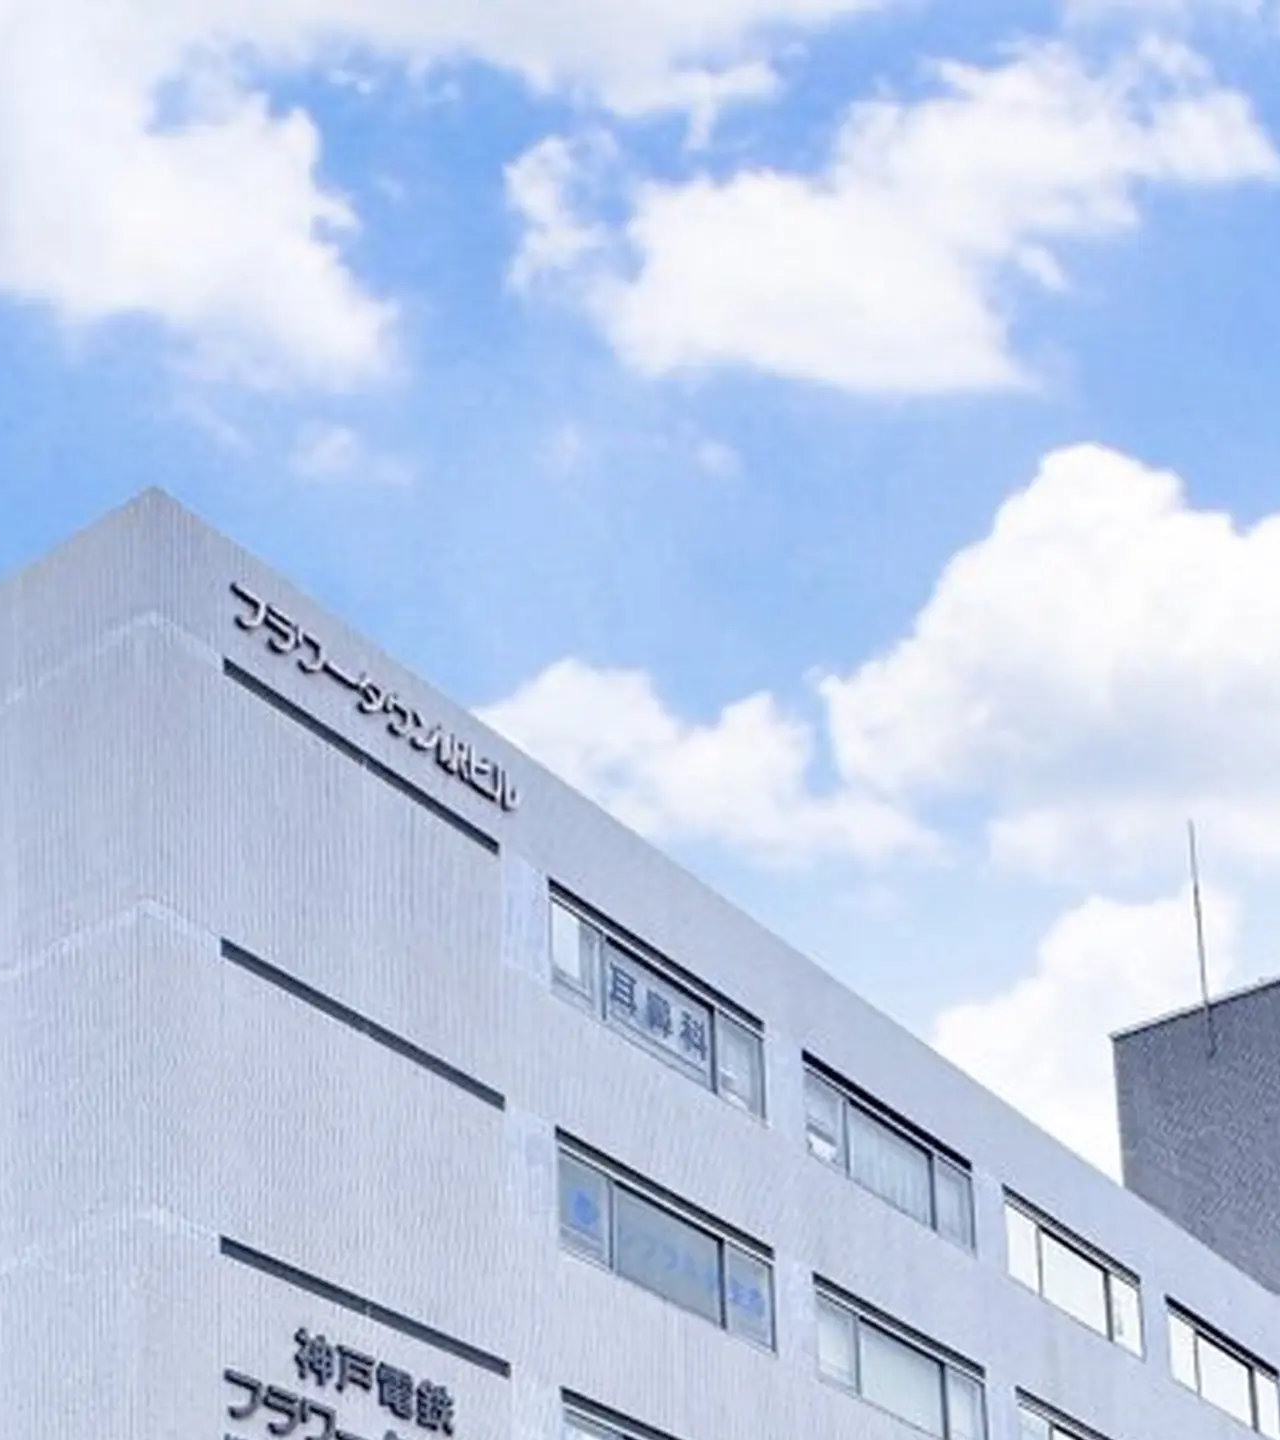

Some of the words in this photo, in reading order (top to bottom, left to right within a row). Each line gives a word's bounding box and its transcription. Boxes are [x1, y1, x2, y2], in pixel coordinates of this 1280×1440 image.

[229, 581, 520, 811] フラワータウン駅ビル
[294, 1326, 454, 1436] 神戸電鉄
